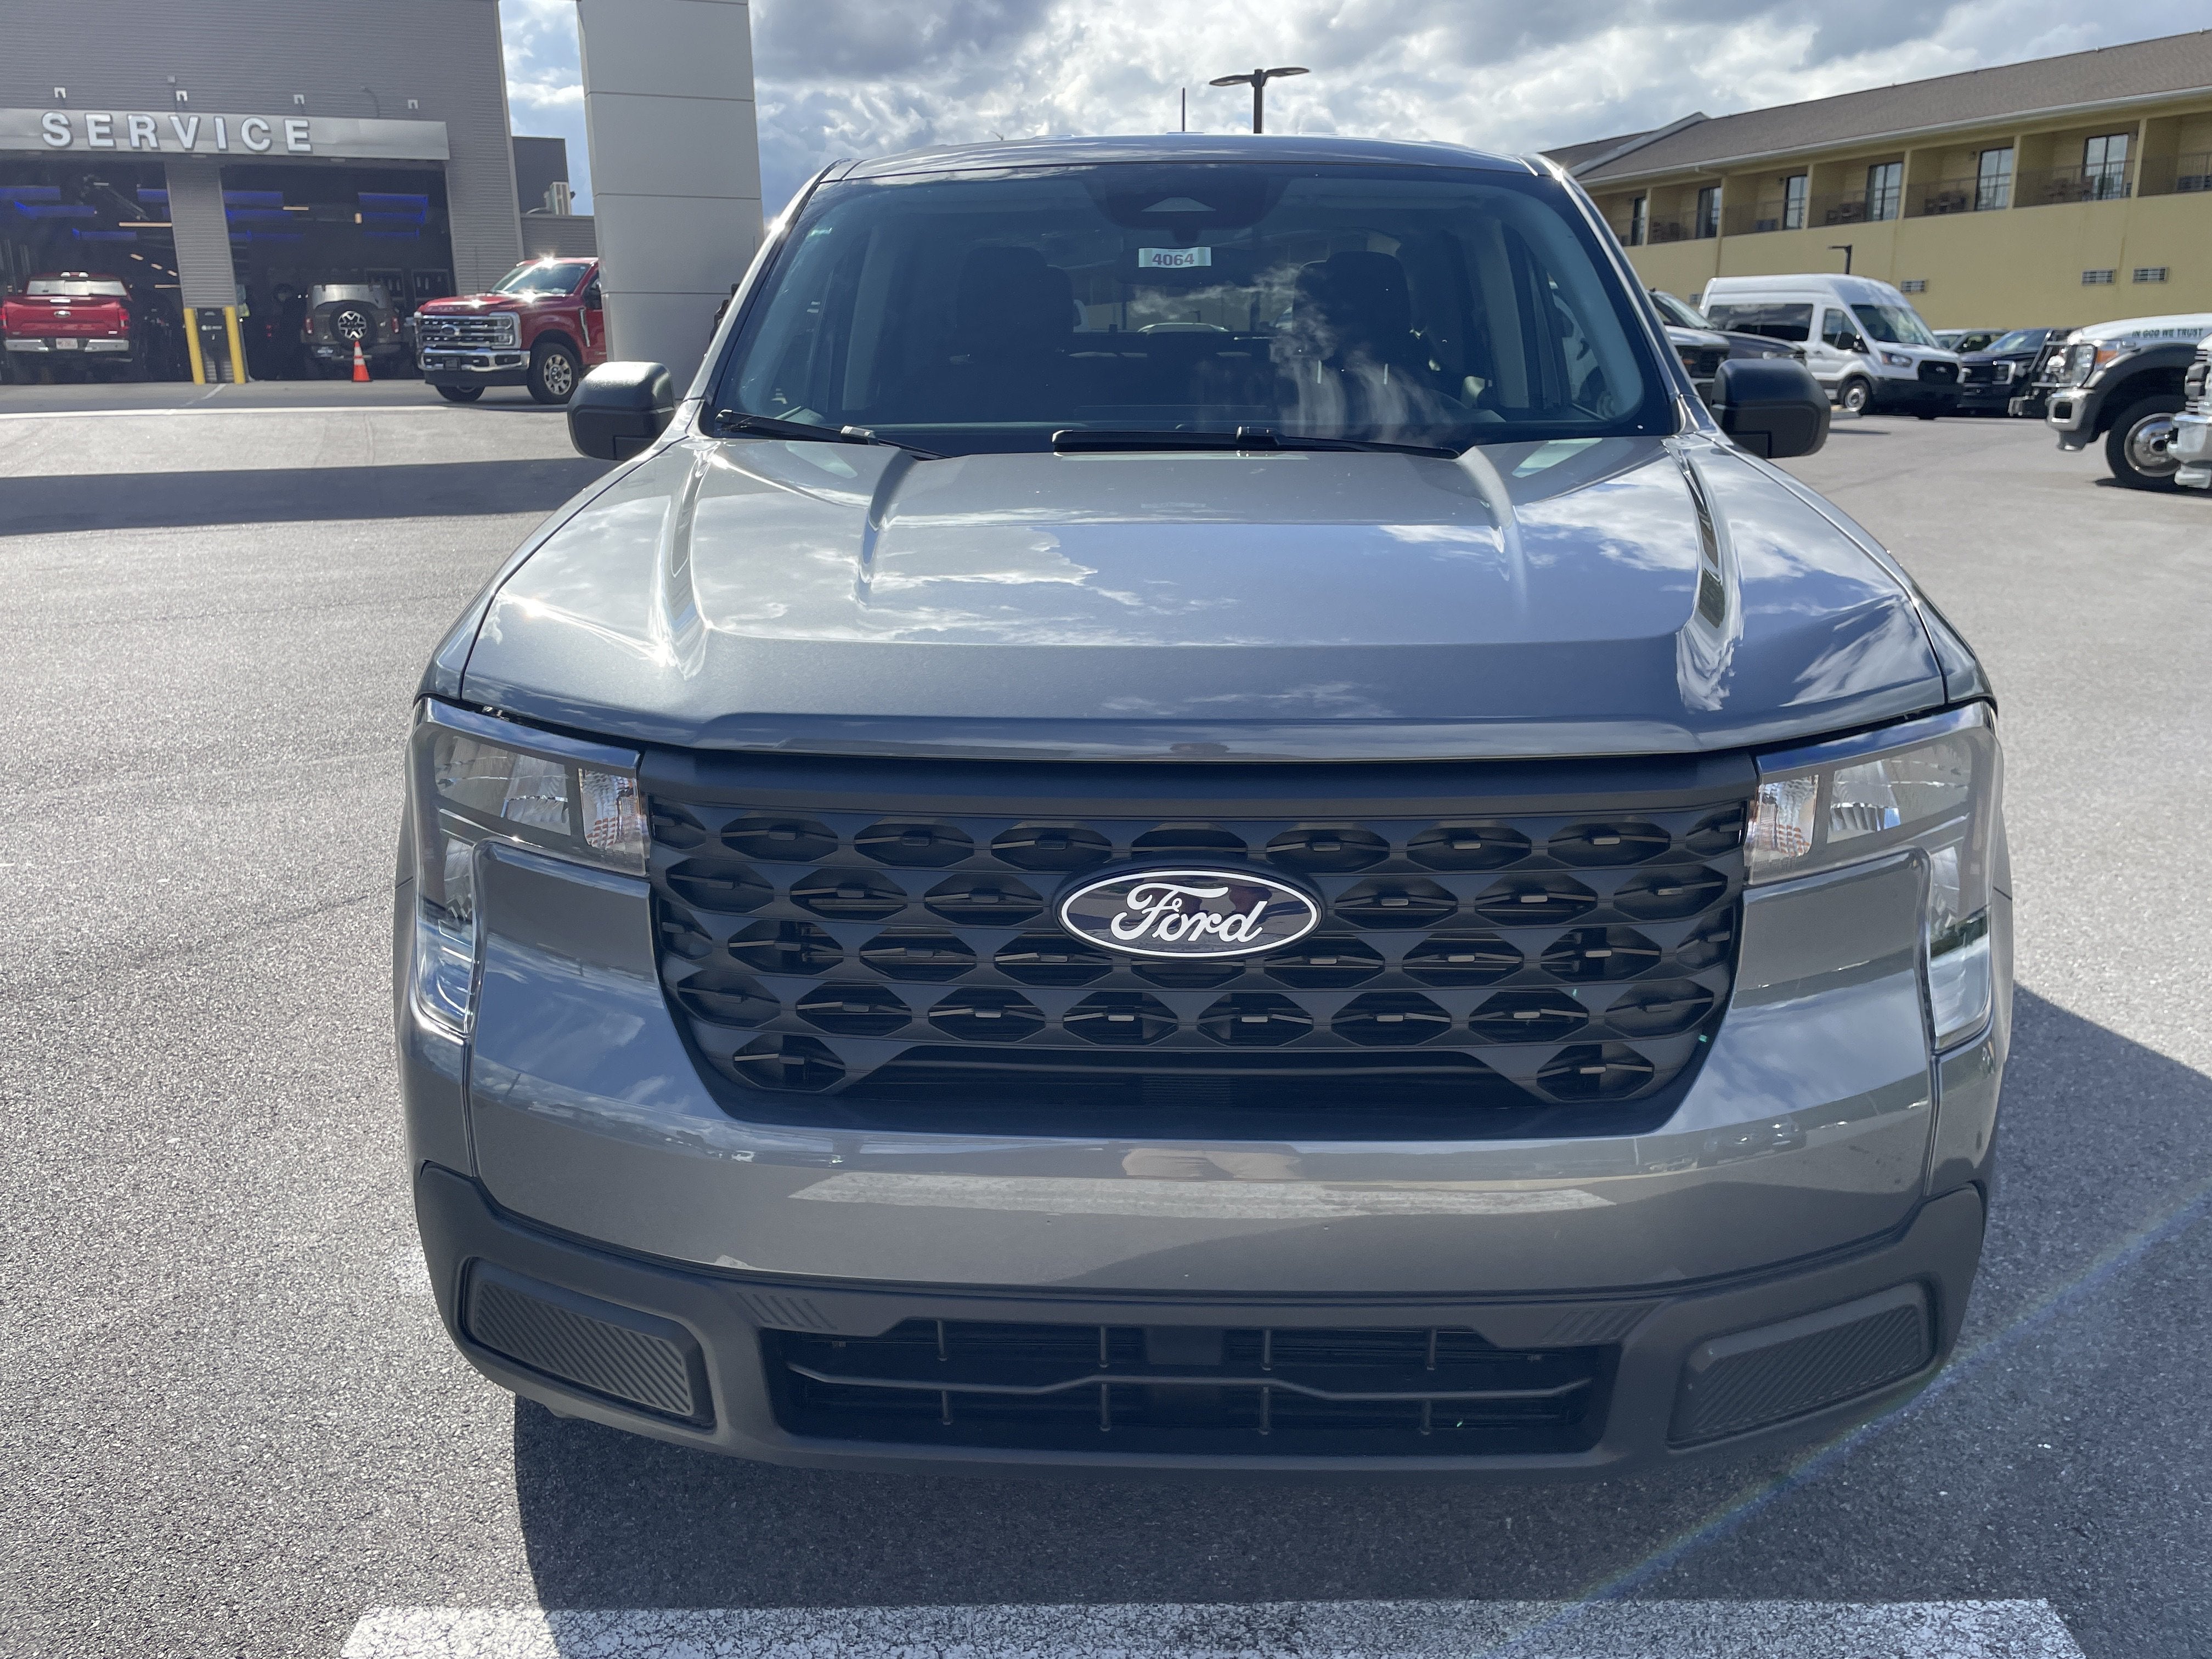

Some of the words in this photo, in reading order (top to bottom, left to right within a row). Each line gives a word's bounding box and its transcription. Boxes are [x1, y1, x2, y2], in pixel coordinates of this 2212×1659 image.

[41, 111, 312, 152] SERVICE
[1152, 253, 1195, 266] 4064
[2177, 328, 2203, 338] TRUST
[1110, 882, 1268, 943] Ford
